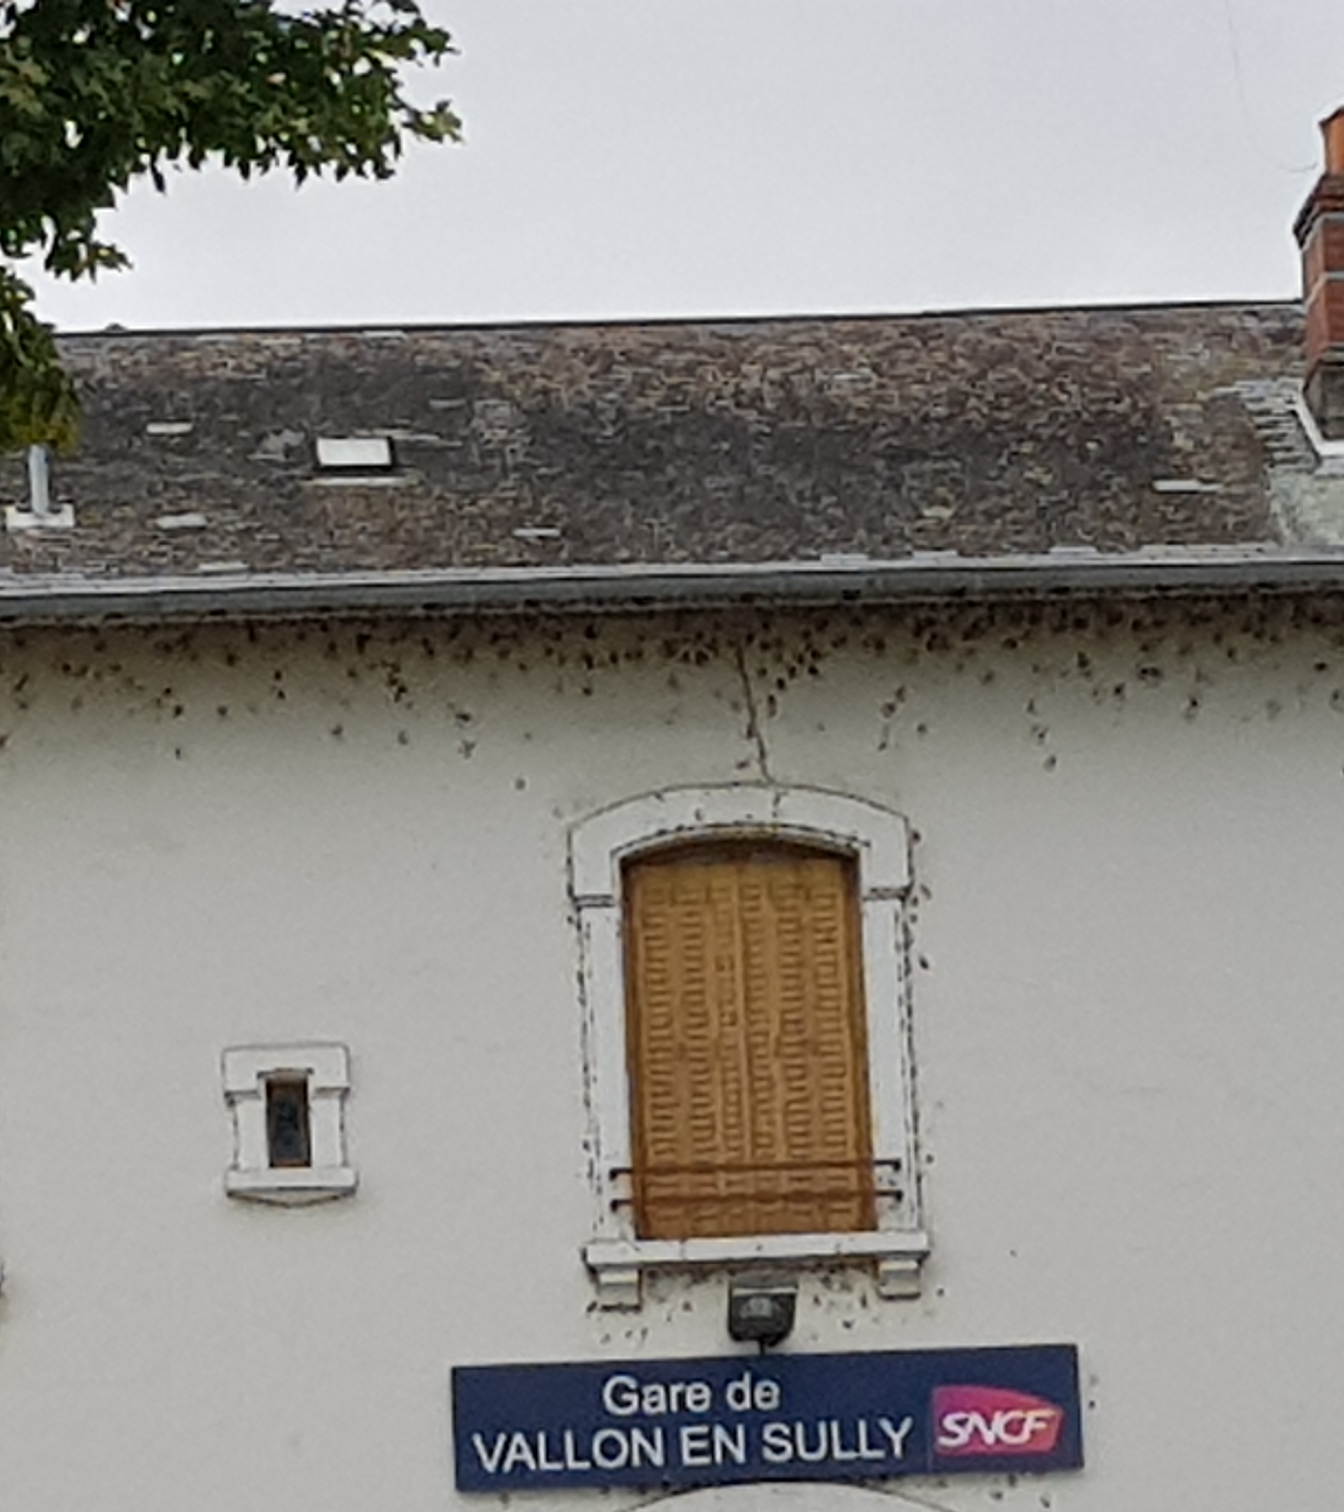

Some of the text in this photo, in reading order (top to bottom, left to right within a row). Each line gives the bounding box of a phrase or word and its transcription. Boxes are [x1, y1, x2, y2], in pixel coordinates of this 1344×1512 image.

[602, 1371, 781, 1416] Gare de
[471, 1416, 913, 1474] VALLON EN SULLY
[937, 1409, 1056, 1447] SNCF
